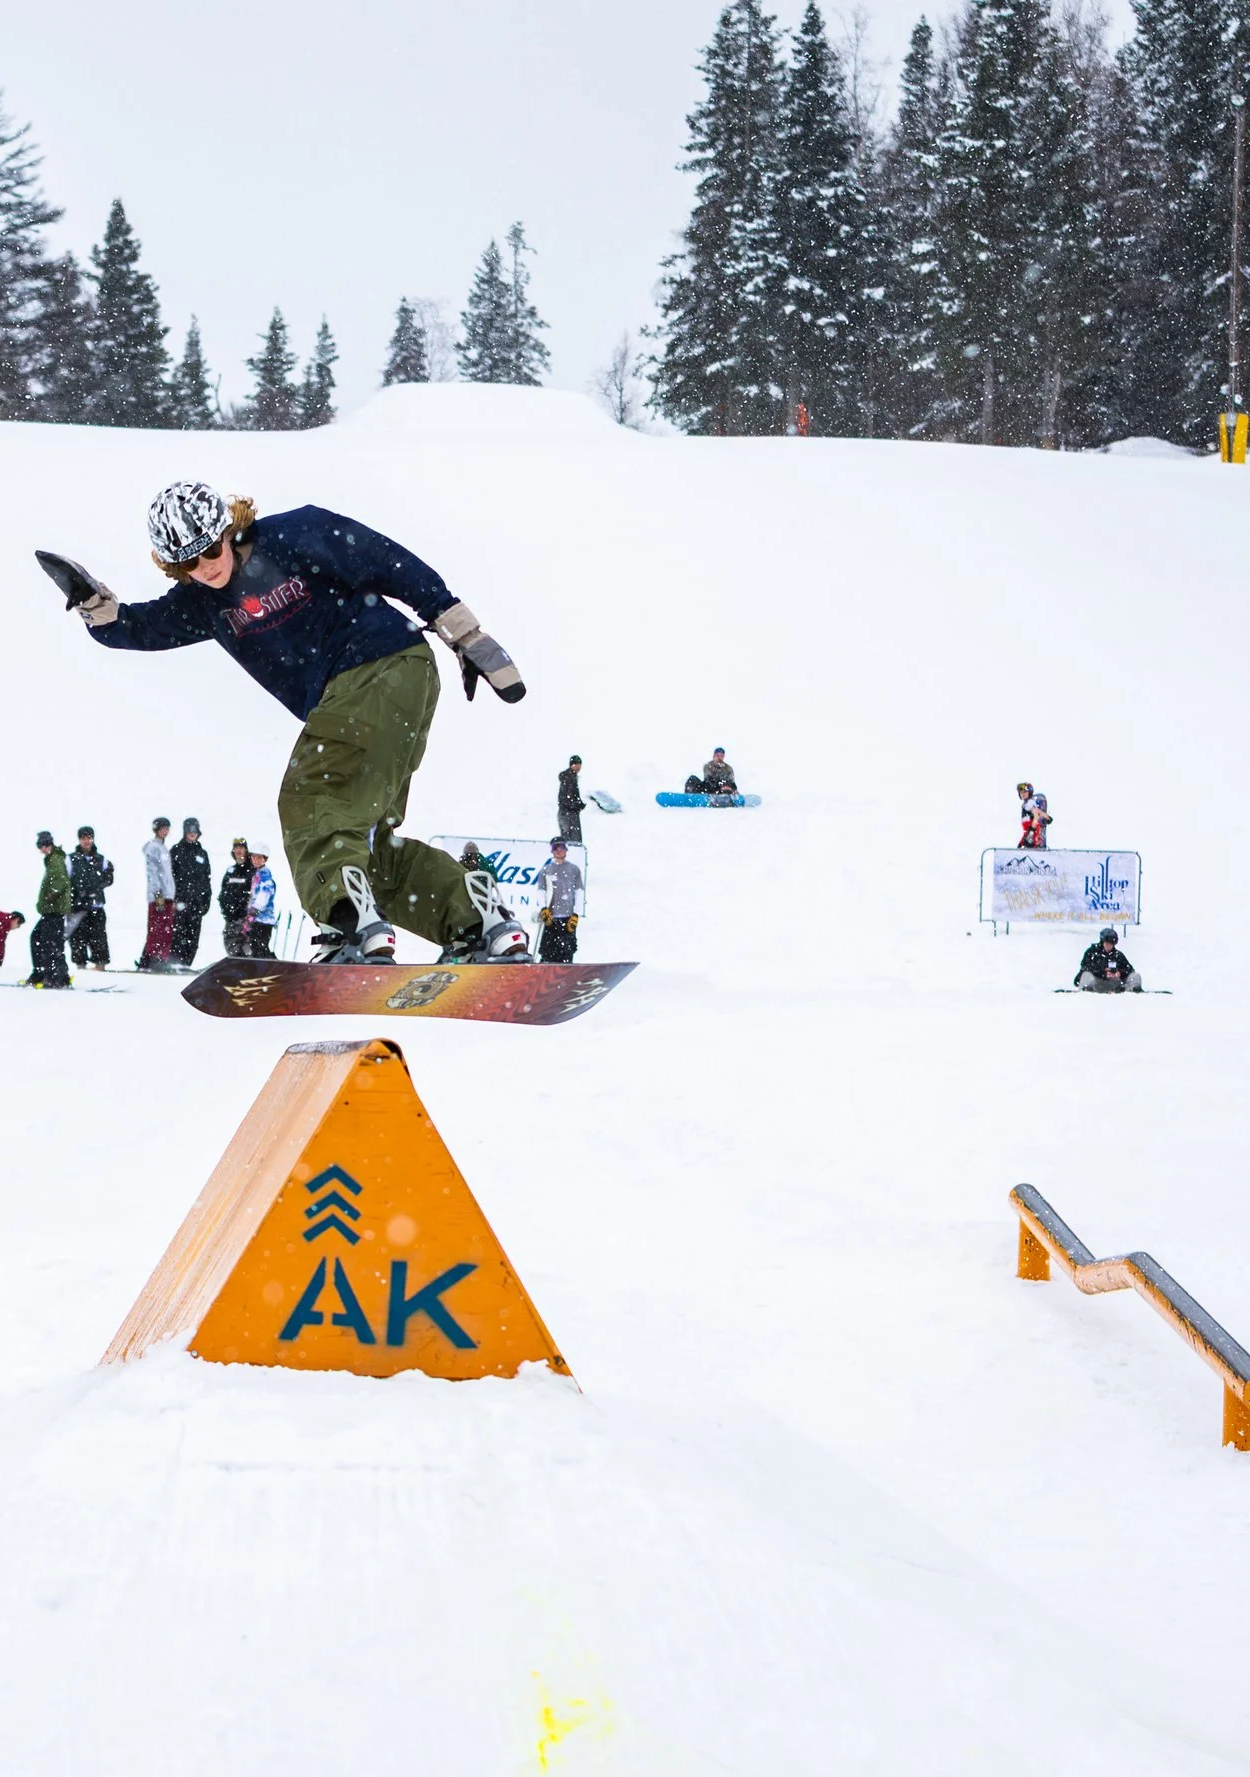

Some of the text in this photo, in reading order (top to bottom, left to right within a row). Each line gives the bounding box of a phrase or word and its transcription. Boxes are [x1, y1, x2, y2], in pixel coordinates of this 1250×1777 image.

[220, 578, 307, 636] THRSHER
[486, 851, 553, 886] las
[278, 1256, 479, 1349] AK
